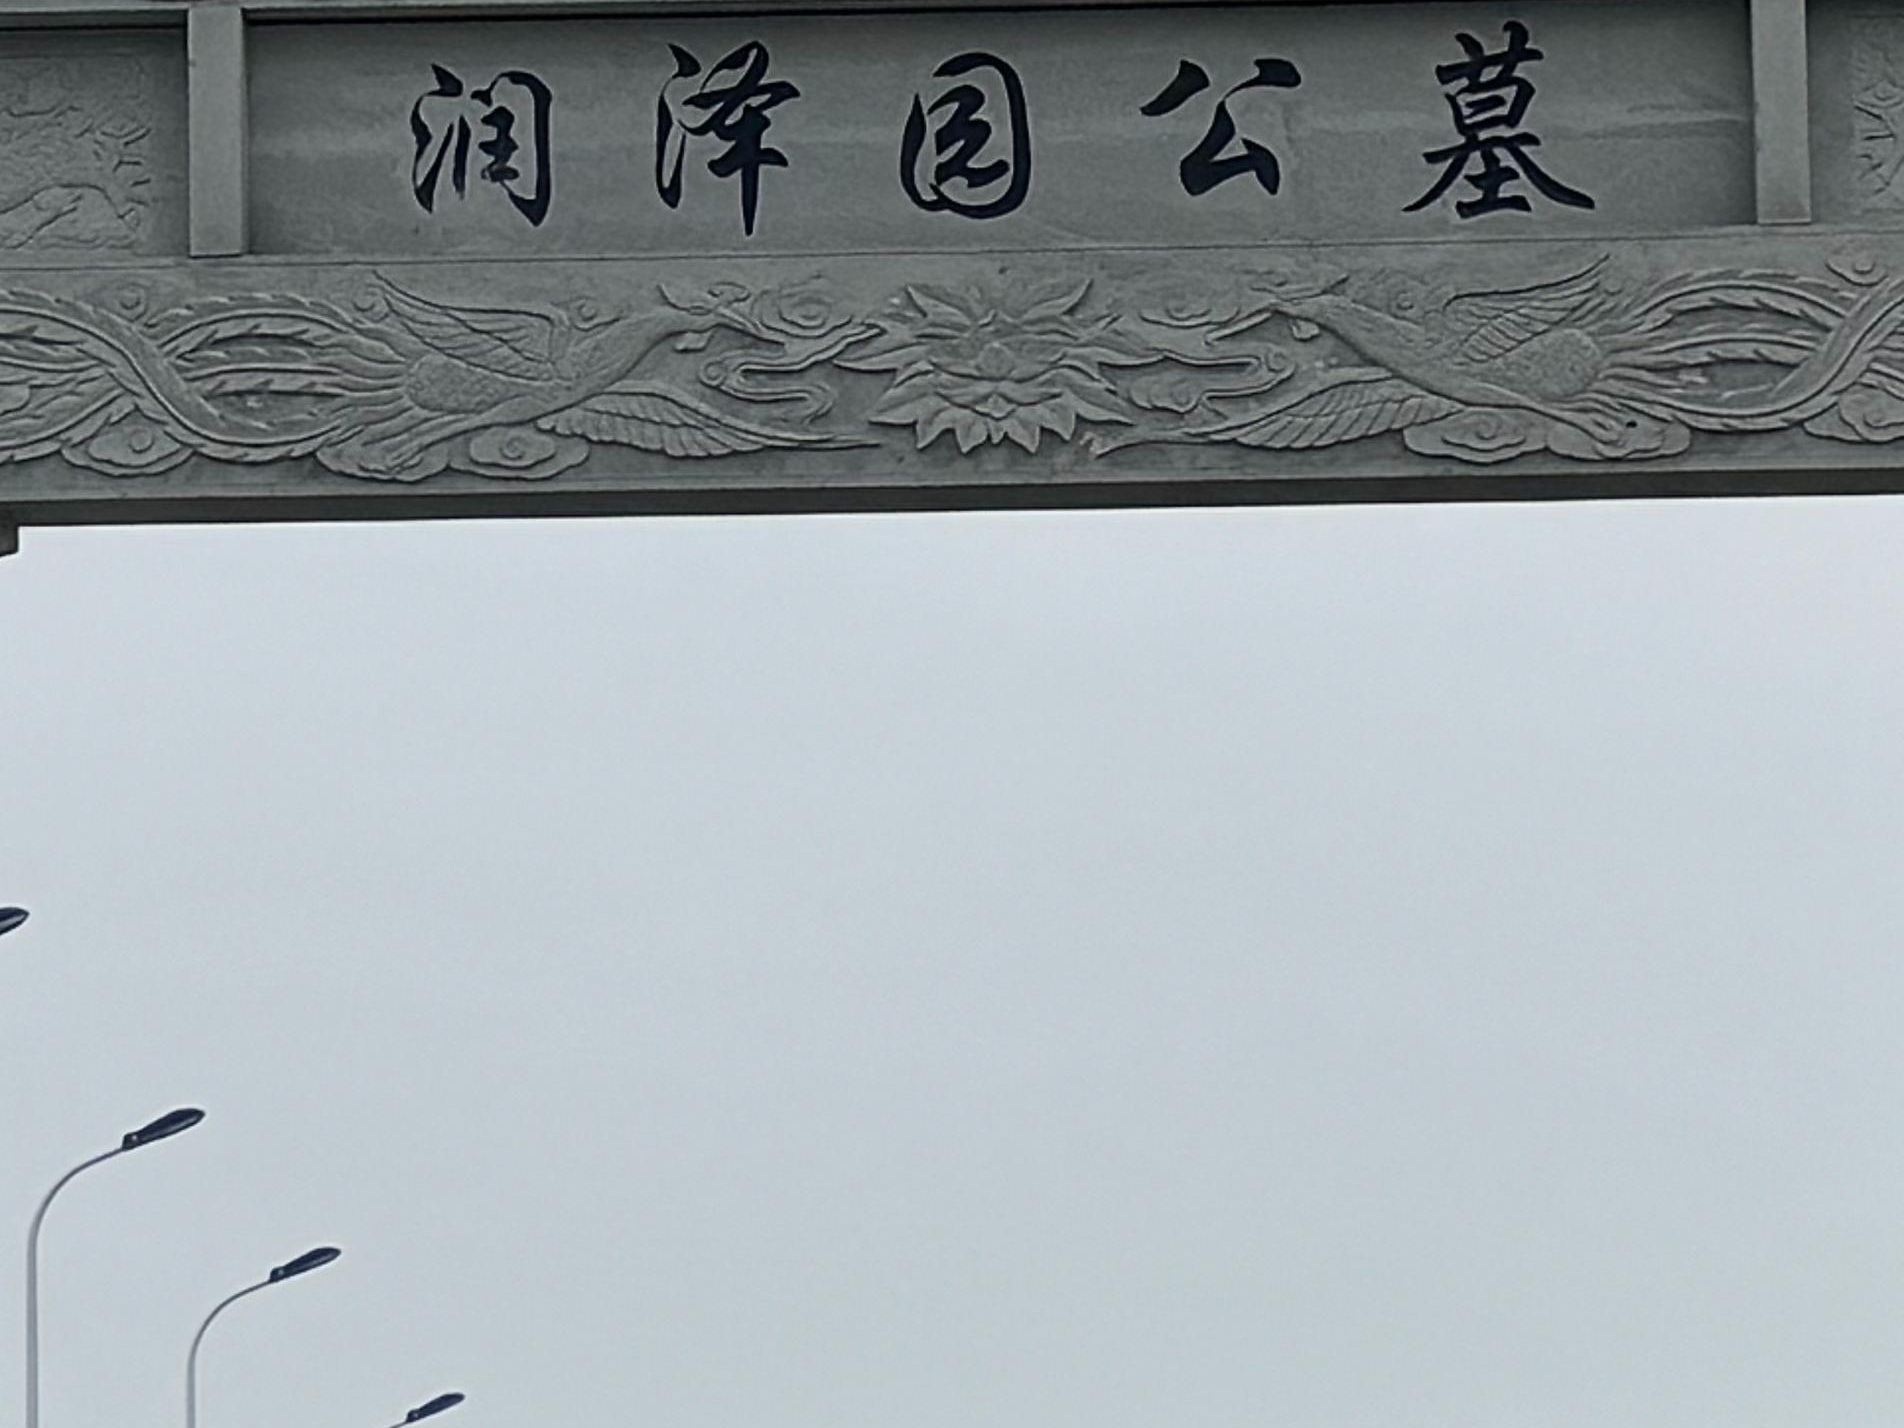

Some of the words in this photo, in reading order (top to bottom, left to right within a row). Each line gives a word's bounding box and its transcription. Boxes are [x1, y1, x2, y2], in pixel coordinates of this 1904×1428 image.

[409, 19, 1597, 237] 润泽园公墓
